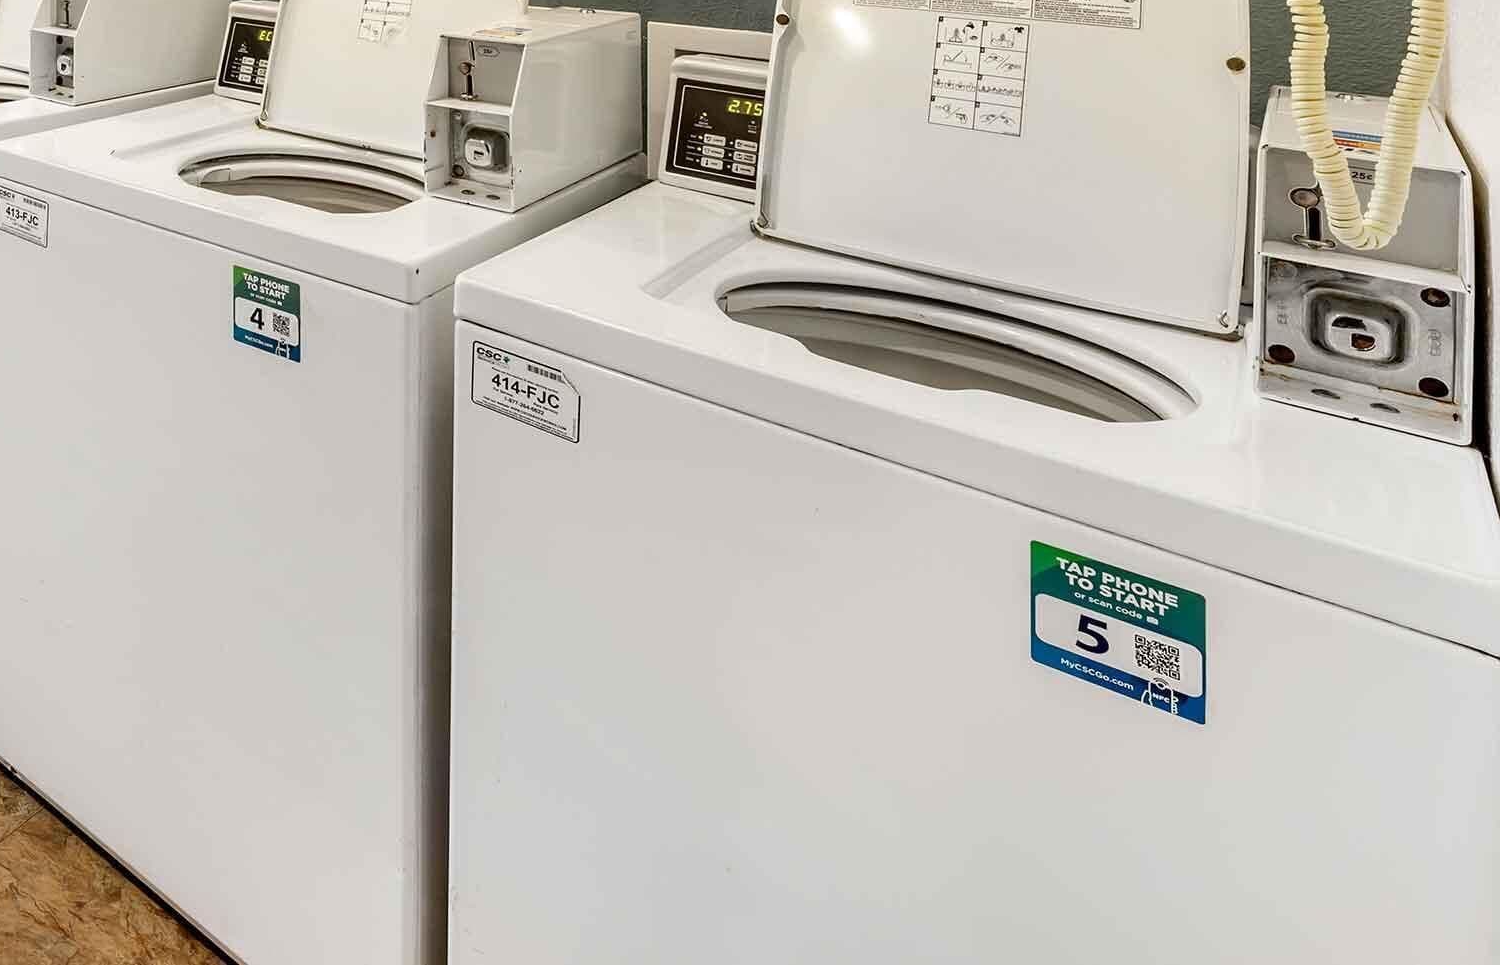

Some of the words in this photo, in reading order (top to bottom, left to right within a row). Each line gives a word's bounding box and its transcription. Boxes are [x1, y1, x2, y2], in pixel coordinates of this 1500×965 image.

[727, 99, 763, 117] 2.75
[5, 206, 39, 226] 413-FJC
[243, 272, 259, 283] TAP
[260, 278, 290, 293] PHONE
[246, 281, 258, 291] TO
[260, 286, 286, 300] START
[250, 307, 265, 330] 4
[476, 347, 502, 361] CSC
[491, 373, 560, 409] 414-FJC
[1056, 556, 1097, 577] TAP
[1101, 571, 1179, 608] PHONE
[1065, 572, 1094, 591] TO
[1099, 584, 1169, 616] START
[1074, 592, 1086, 600] or
[1088, 596, 1113, 610] scan
[1115, 605, 1143, 619] code
[1075, 614, 1110, 655] 5
